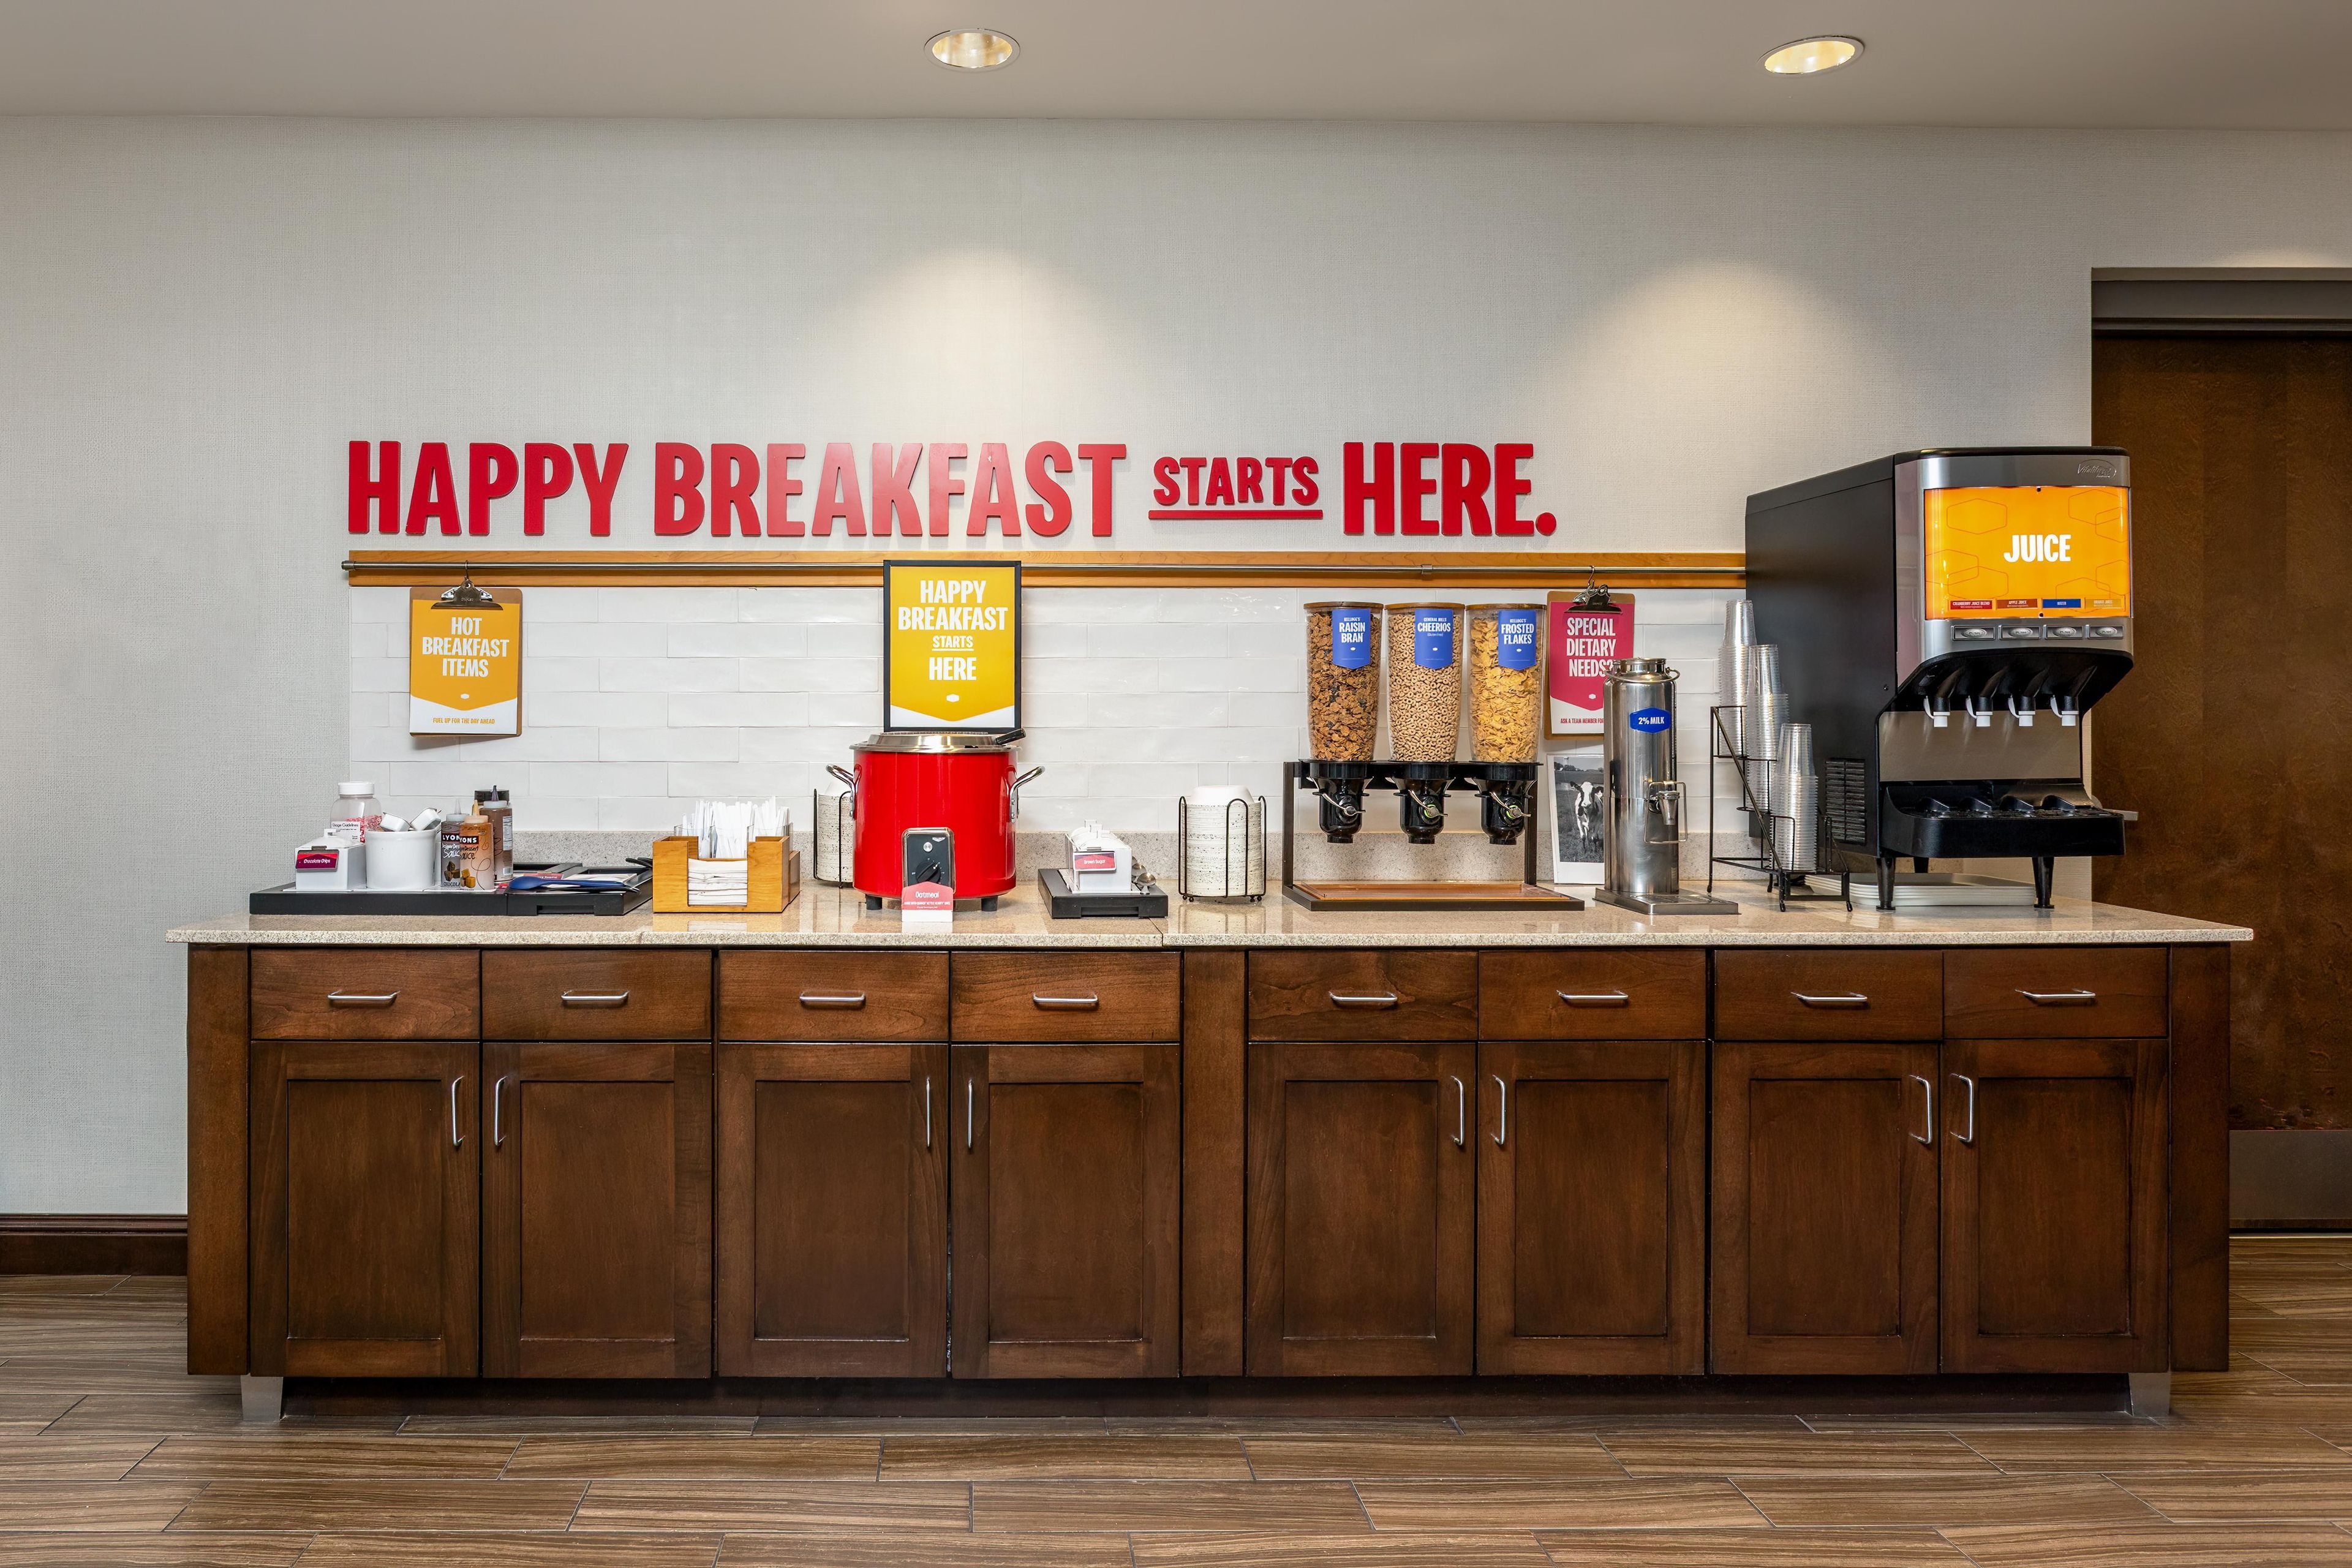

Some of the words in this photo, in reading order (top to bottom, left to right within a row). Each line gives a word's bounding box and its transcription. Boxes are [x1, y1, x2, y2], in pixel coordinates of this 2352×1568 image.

[348, 440, 629, 537] HAPPY
[654, 442, 1126, 538] BREAKFAST
[1153, 456, 1320, 506] STARTS
[1343, 442, 1557, 537] HERE.
[2003, 534, 2071, 563] JUICE
[920, 580, 987, 603] HAPPY
[451, 617, 483, 636] HOT
[898, 606, 1008, 631] BREAKFAST
[1339, 622, 1366, 633] RAISIN
[1417, 622, 1451, 632] CHEERIOS
[1567, 617, 1616, 636] SPECIAL
[1341, 633, 1363, 643] BRAN
[1501, 624, 1534, 634] FROSTED
[422, 636, 510, 657] BREAKFAST
[932, 635, 974, 649] STARTS
[1504, 634, 1532, 644] FLAKES
[1566, 638, 1616, 657] DIETARY
[442, 658, 489, 677] ITEMS
[929, 657, 977, 680] HERE
